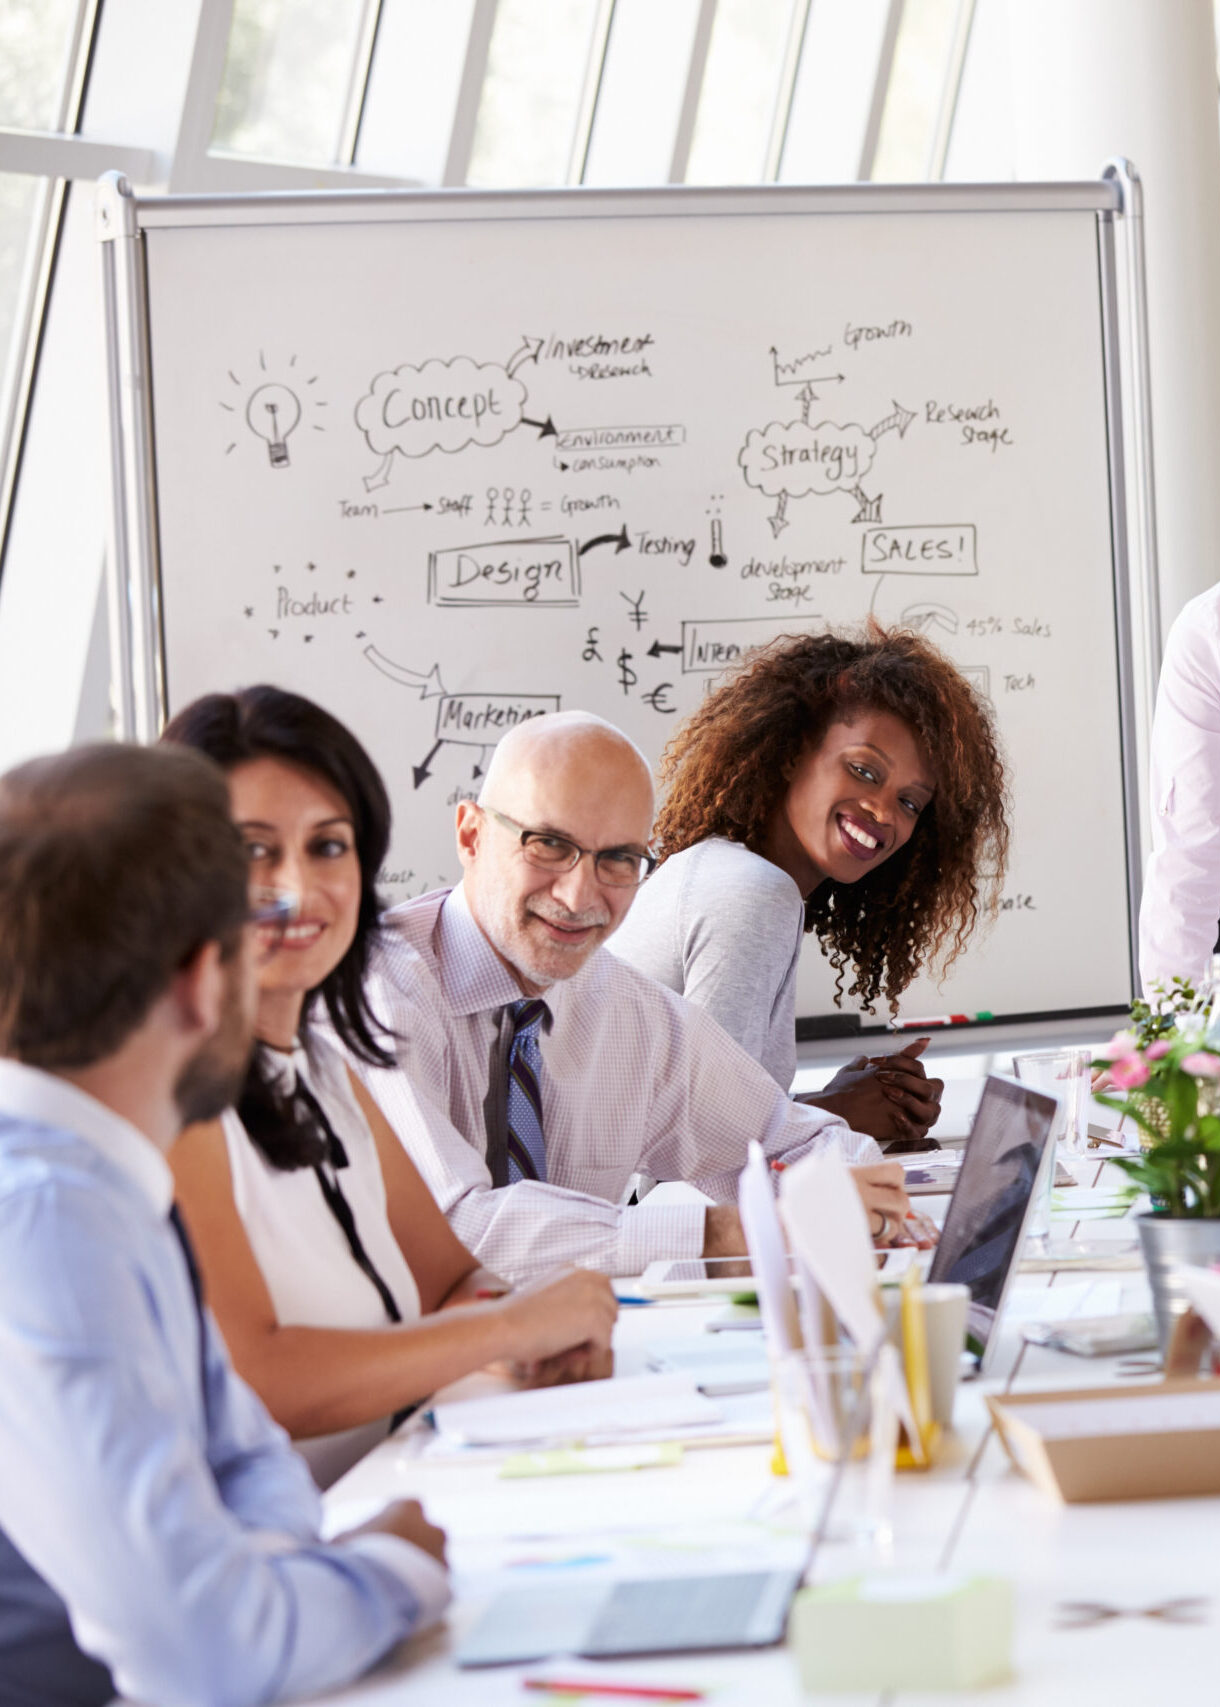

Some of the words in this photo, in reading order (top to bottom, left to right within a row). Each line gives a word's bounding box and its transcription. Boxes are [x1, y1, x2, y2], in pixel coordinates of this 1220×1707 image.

[545, 332, 656, 361] Investment
[844, 319, 913, 350] Growth
[382, 387, 502, 428] Concept
[925, 398, 1001, 424] Research
[558, 428, 678, 449] Environment
[760, 439, 859, 481] Strategy
[339, 499, 379, 519] Team
[435, 494, 474, 518] Staff
[560, 493, 621, 517] Growth
[635, 529, 697, 567] Testing
[868, 532, 966, 564] SALES!
[447, 553, 563, 602] Design
[740, 554, 848, 581] development
[276, 585, 354, 620] Product
[1010, 616, 1053, 638] Sales
[1002, 671, 1037, 695] Tech
[442, 699, 547, 730] Marketin
